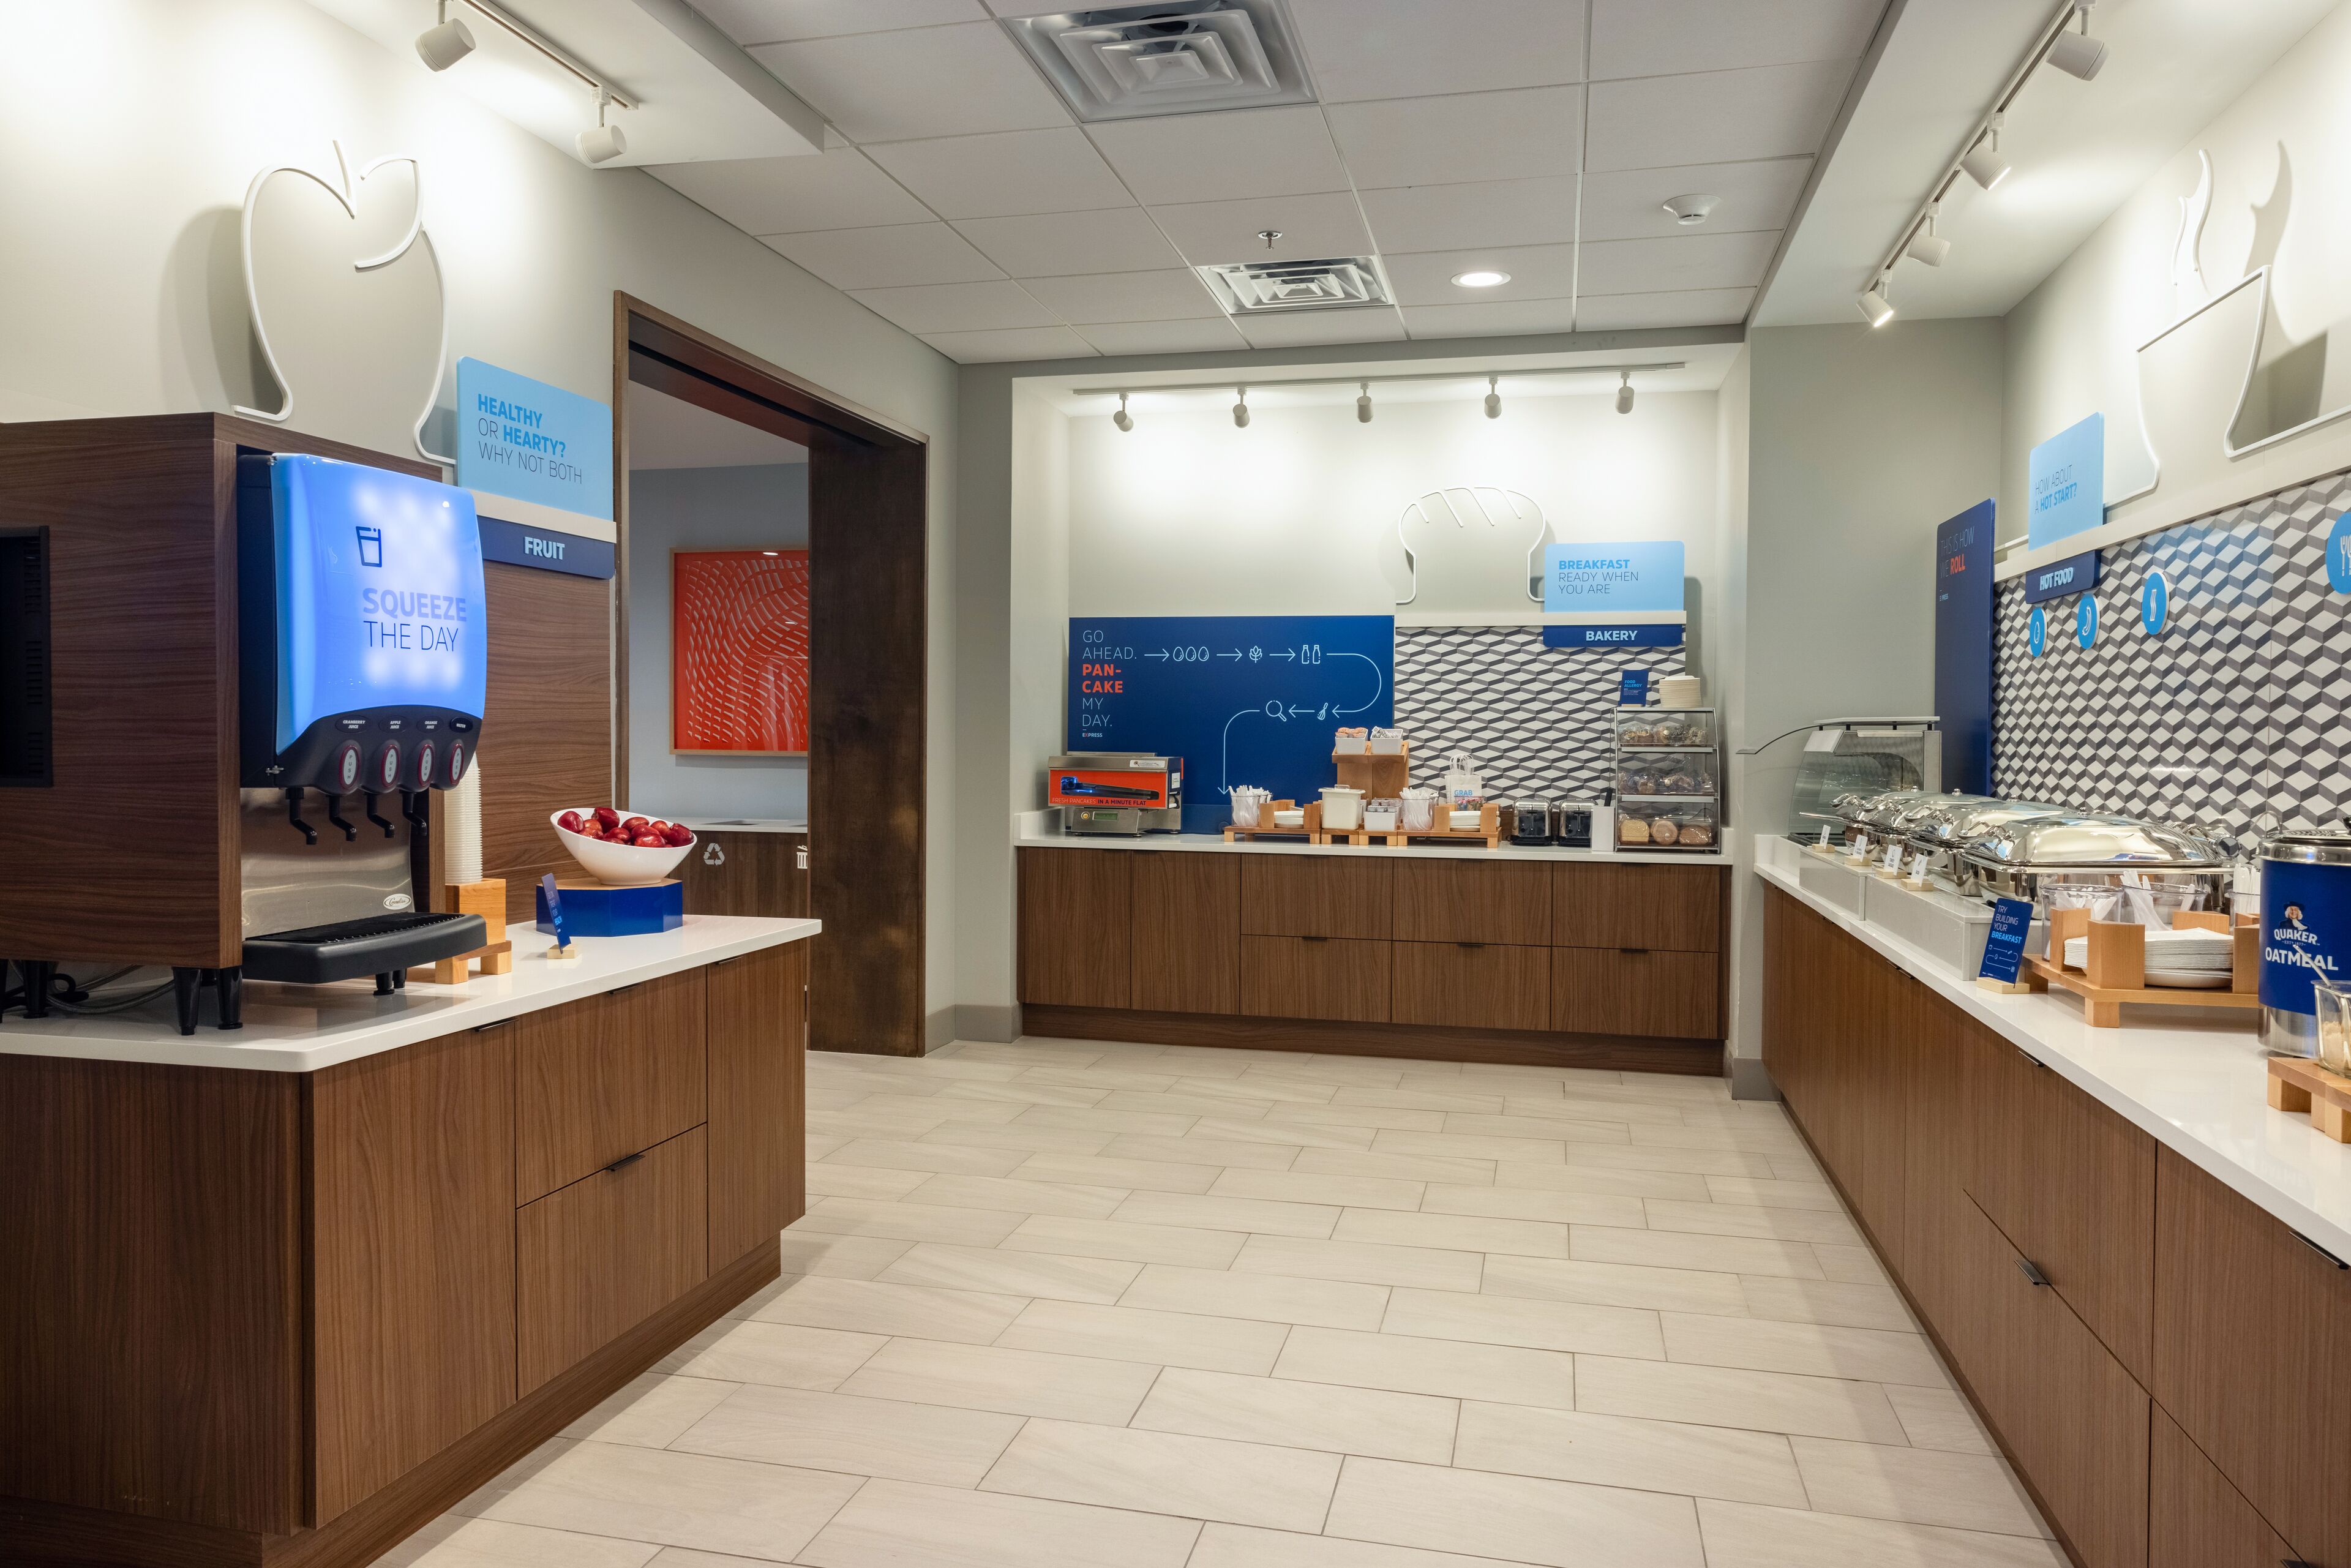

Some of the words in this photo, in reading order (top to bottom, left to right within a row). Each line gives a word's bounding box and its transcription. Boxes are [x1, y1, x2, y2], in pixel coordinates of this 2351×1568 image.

[478, 394, 542, 429] HEALTHY
[478, 418, 498, 440] OR
[503, 425, 566, 457] HEARTY?
[479, 440, 513, 466] WHY
[519, 451, 544, 475] NOT
[549, 460, 582, 484] BOTH
[2035, 475, 2050, 495] HOW
[2052, 464, 2072, 488] ABOUT
[2034, 500, 2039, 514] A
[2040, 494, 2052, 512] HOT
[2053, 482, 2077, 506] START?
[524, 536, 565, 560] FRUIT
[1941, 536, 1952, 557] THIS
[1953, 533, 1959, 551] IS
[1959, 526, 1974, 549] HOW
[1559, 560, 1630, 570] BREAKFAST
[1940, 560, 1949, 579] WE
[1950, 553, 1965, 575] ROLL
[1559, 572, 1597, 582] READY
[1602, 571, 1638, 582] WHEN
[2039, 571, 2055, 591] HOT
[2054, 567, 2074, 587] FOOD
[1558, 584, 1583, 594] YOU
[1587, 584, 1610, 594] ARE
[362, 588, 467, 622] SQUEEZE
[363, 620, 411, 650] THE
[421, 625, 459, 652] DAY
[1082, 630, 1104, 643] GO
[1586, 631, 1638, 641] BAKERY
[1082, 647, 1137, 659] AHEAD.
[1082, 664, 1122, 676] PAN-
[1082, 681, 1123, 693] CAKE
[1082, 697, 1103, 710] MY
[1082, 715, 1112, 727] DAY.
[1998, 905, 2008, 913] TRY
[1995, 913, 2019, 925] BUILDING
[1993, 923, 2008, 932] YOUR
[1991, 931, 2022, 944] BREAKFAST
[2274, 929, 2317, 945] QUAKER
[2265, 947, 2338, 970] OATMEAL
